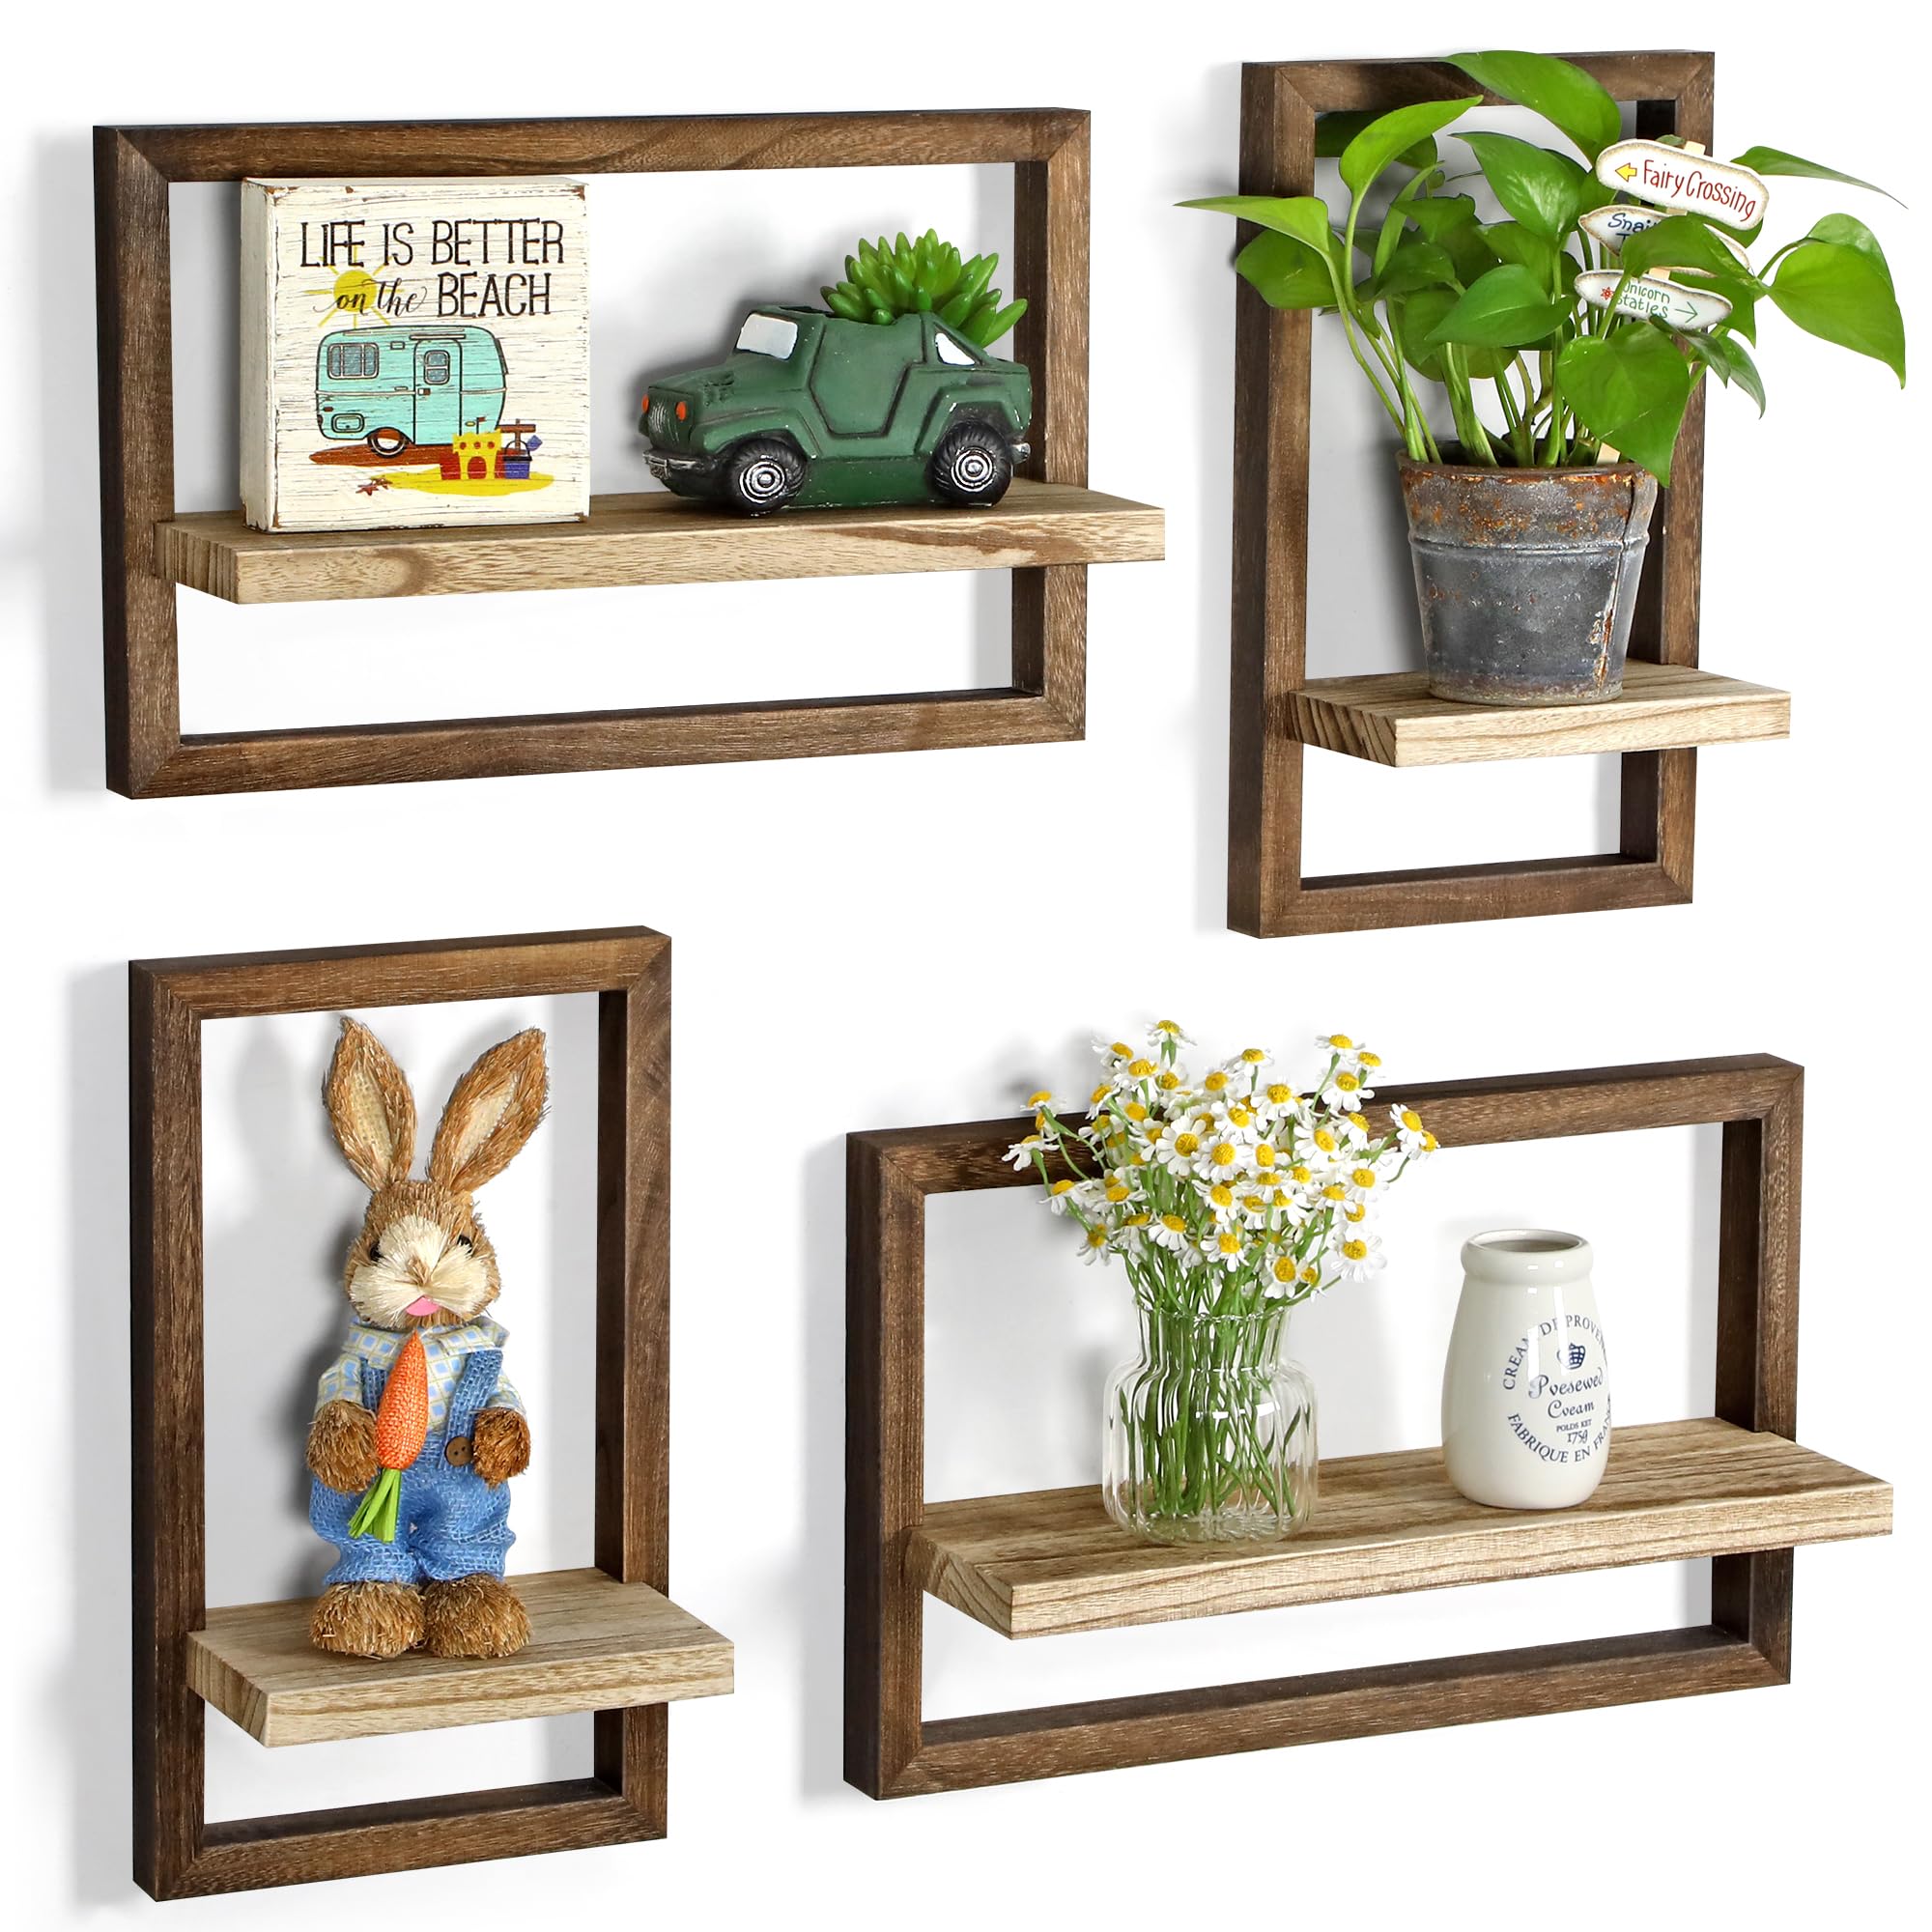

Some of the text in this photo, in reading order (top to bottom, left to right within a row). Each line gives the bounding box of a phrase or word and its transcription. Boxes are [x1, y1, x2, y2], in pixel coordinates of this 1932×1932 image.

[1643, 158, 1756, 222] Fairy Crossing
[299, 217, 564, 268] LIFE IS BETTER
[1607, 212, 1658, 233] Snai
[314, 271, 552, 319] on the BEACH
[1507, 1412, 1570, 1463] FABRIQUE
[1574, 1446, 1592, 1463] EN
